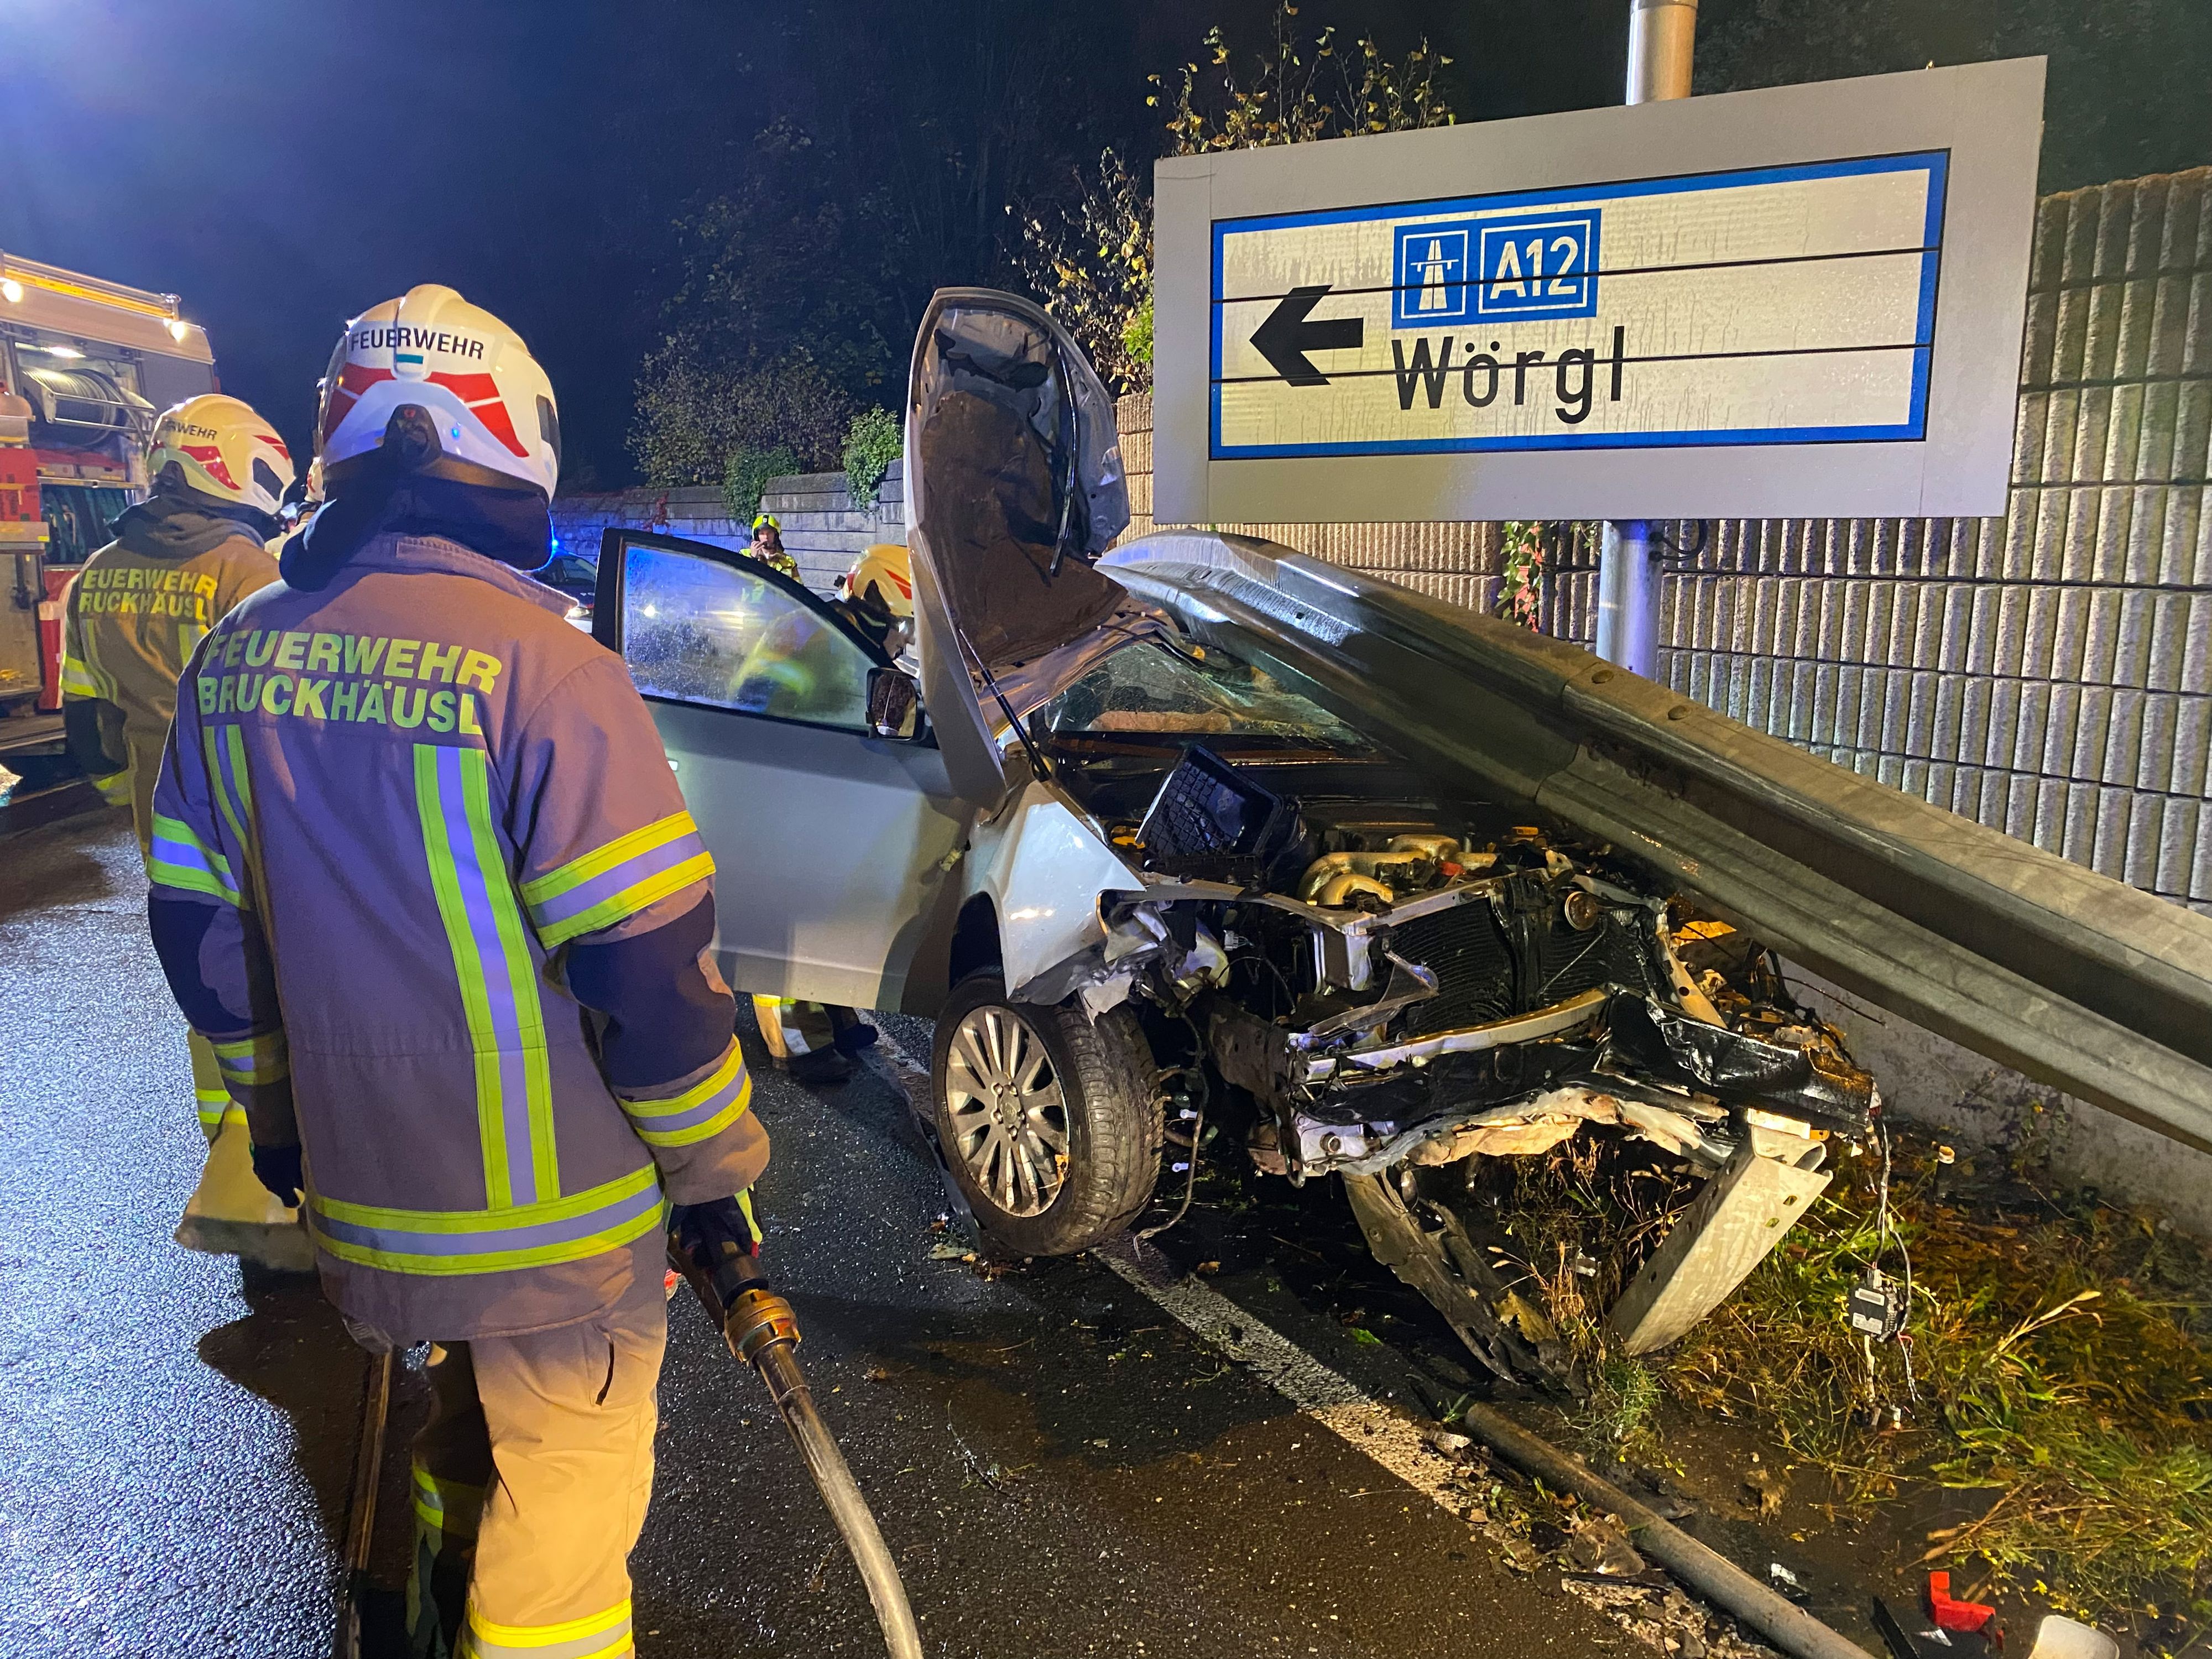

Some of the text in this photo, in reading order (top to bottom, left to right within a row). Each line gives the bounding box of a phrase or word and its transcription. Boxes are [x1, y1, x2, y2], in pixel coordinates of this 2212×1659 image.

[1490, 236, 1579, 299] A12
[351, 327, 484, 359] FEUERWEHR
[1391, 326, 1625, 424] Wörgl
[166, 420, 217, 441] RWEHR
[79, 592, 207, 622] RUCKHÄUSL
[83, 568, 218, 600] EUERWEHR
[202, 630, 502, 695] FEUERWEHR
[197, 674, 483, 735] BRUCKHÄUSL
